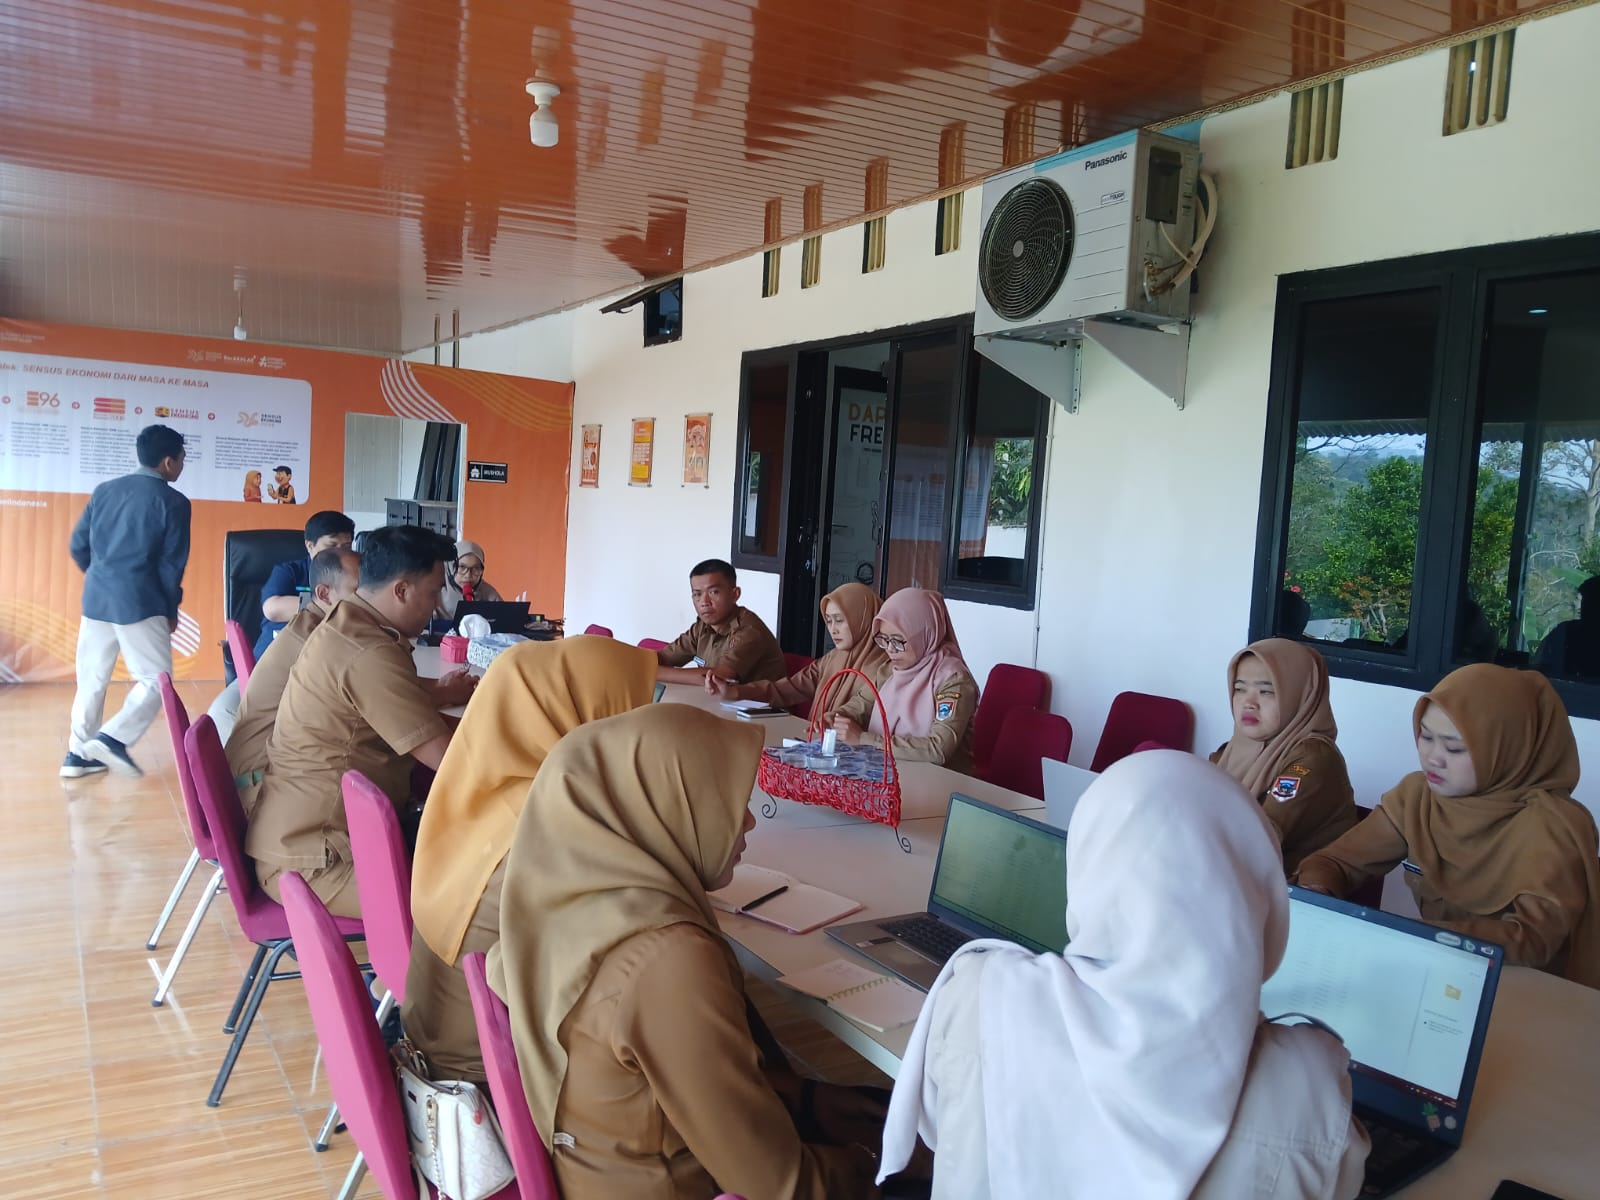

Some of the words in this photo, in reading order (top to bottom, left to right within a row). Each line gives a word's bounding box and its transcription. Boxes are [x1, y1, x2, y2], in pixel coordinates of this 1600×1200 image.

[1085, 150, 1128, 171] Panasonic
[22, 364, 63, 376] SENSUS
[65, 368, 111, 379] EKONOMI
[113, 372, 137, 382] DARI
[138, 375, 166, 385] MASA
[168, 377, 181, 386] KE
[182, 379, 209, 388] MASA
[850, 424, 883, 444] FRE
